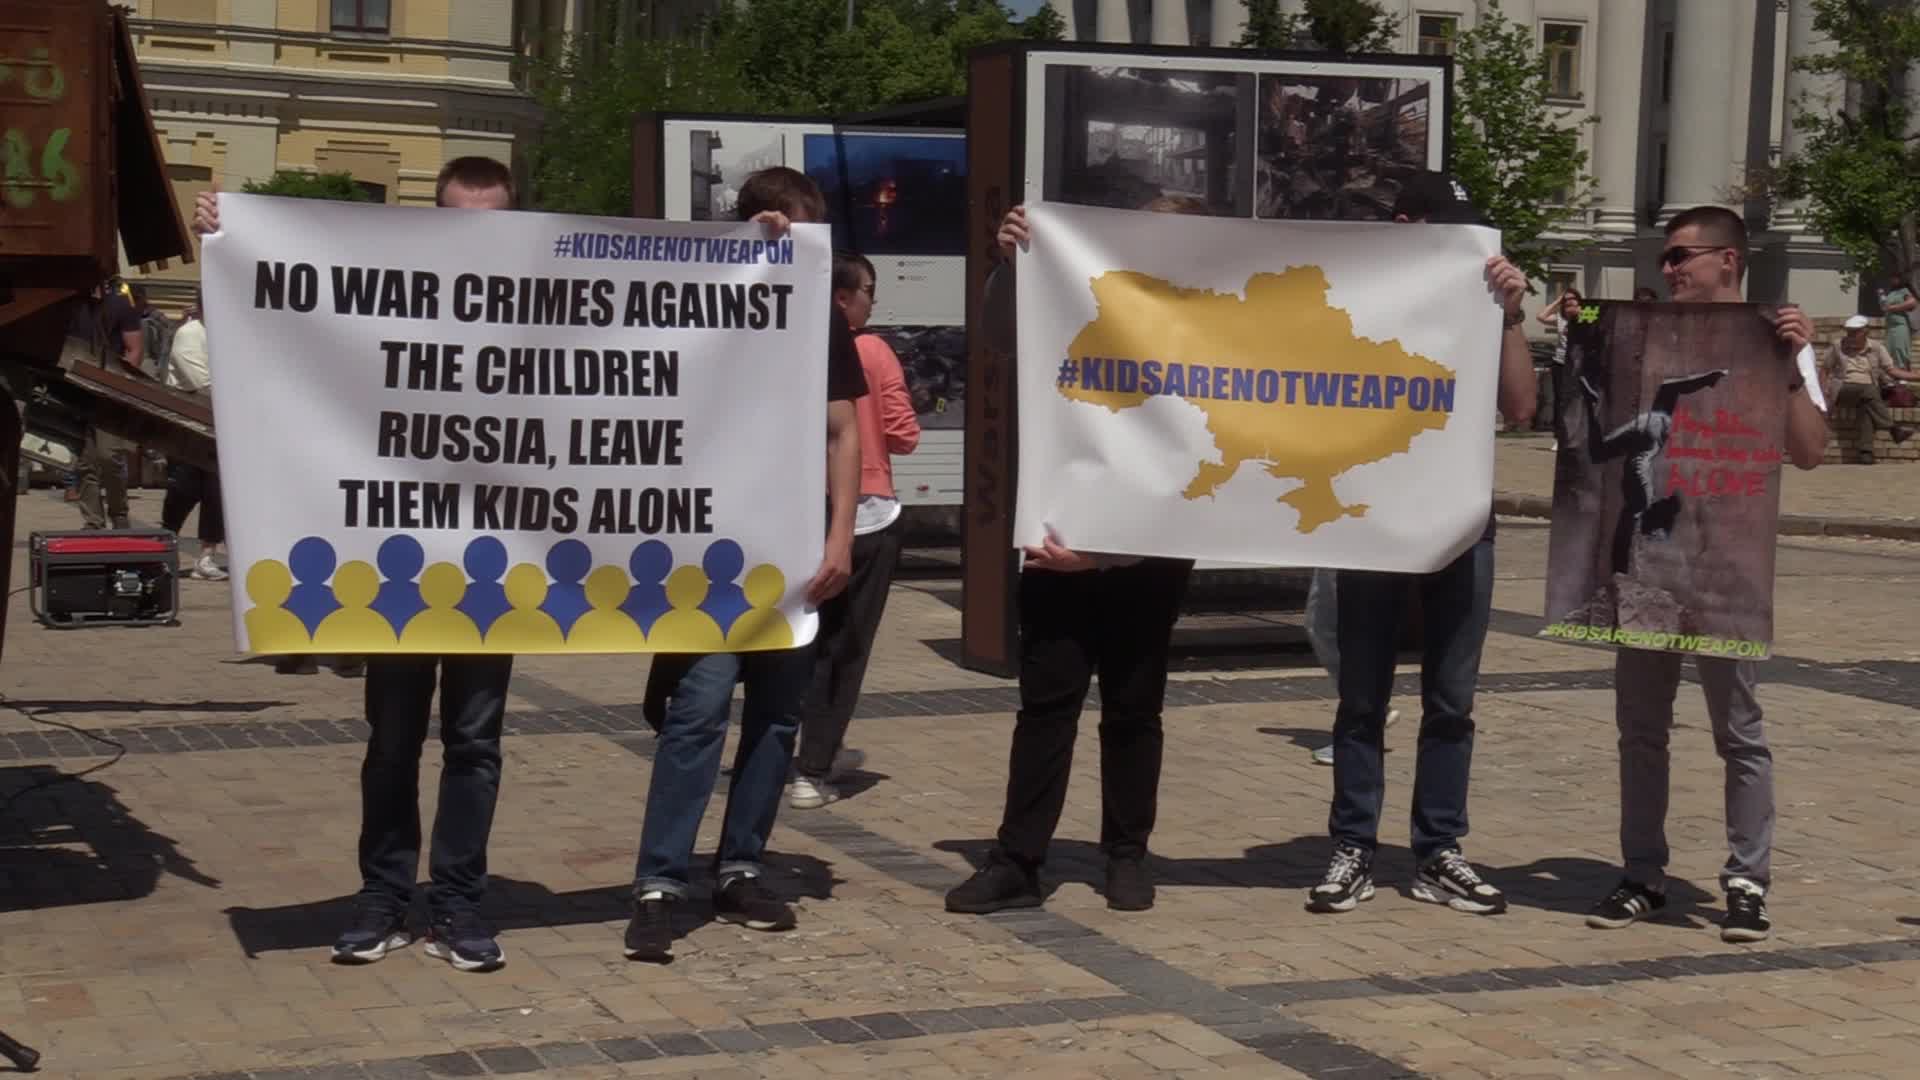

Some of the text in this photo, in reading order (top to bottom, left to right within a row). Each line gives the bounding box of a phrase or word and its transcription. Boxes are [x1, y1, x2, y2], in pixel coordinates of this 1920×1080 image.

[553, 232, 794, 265] #KIDSARENOTWEAPON
[255, 261, 793, 330] NO WAR CRIMES AGAINST
[381, 341, 678, 396] THE CHILDREN
[1057, 357, 1457, 413] #KIDSARENOTWEAPON
[378, 411, 683, 469] RUSSIA, LEAVE
[340, 480, 713, 534] THEM KIDS ALONE
[1546, 623, 1768, 657] #KIDSARENOTWEAPON
